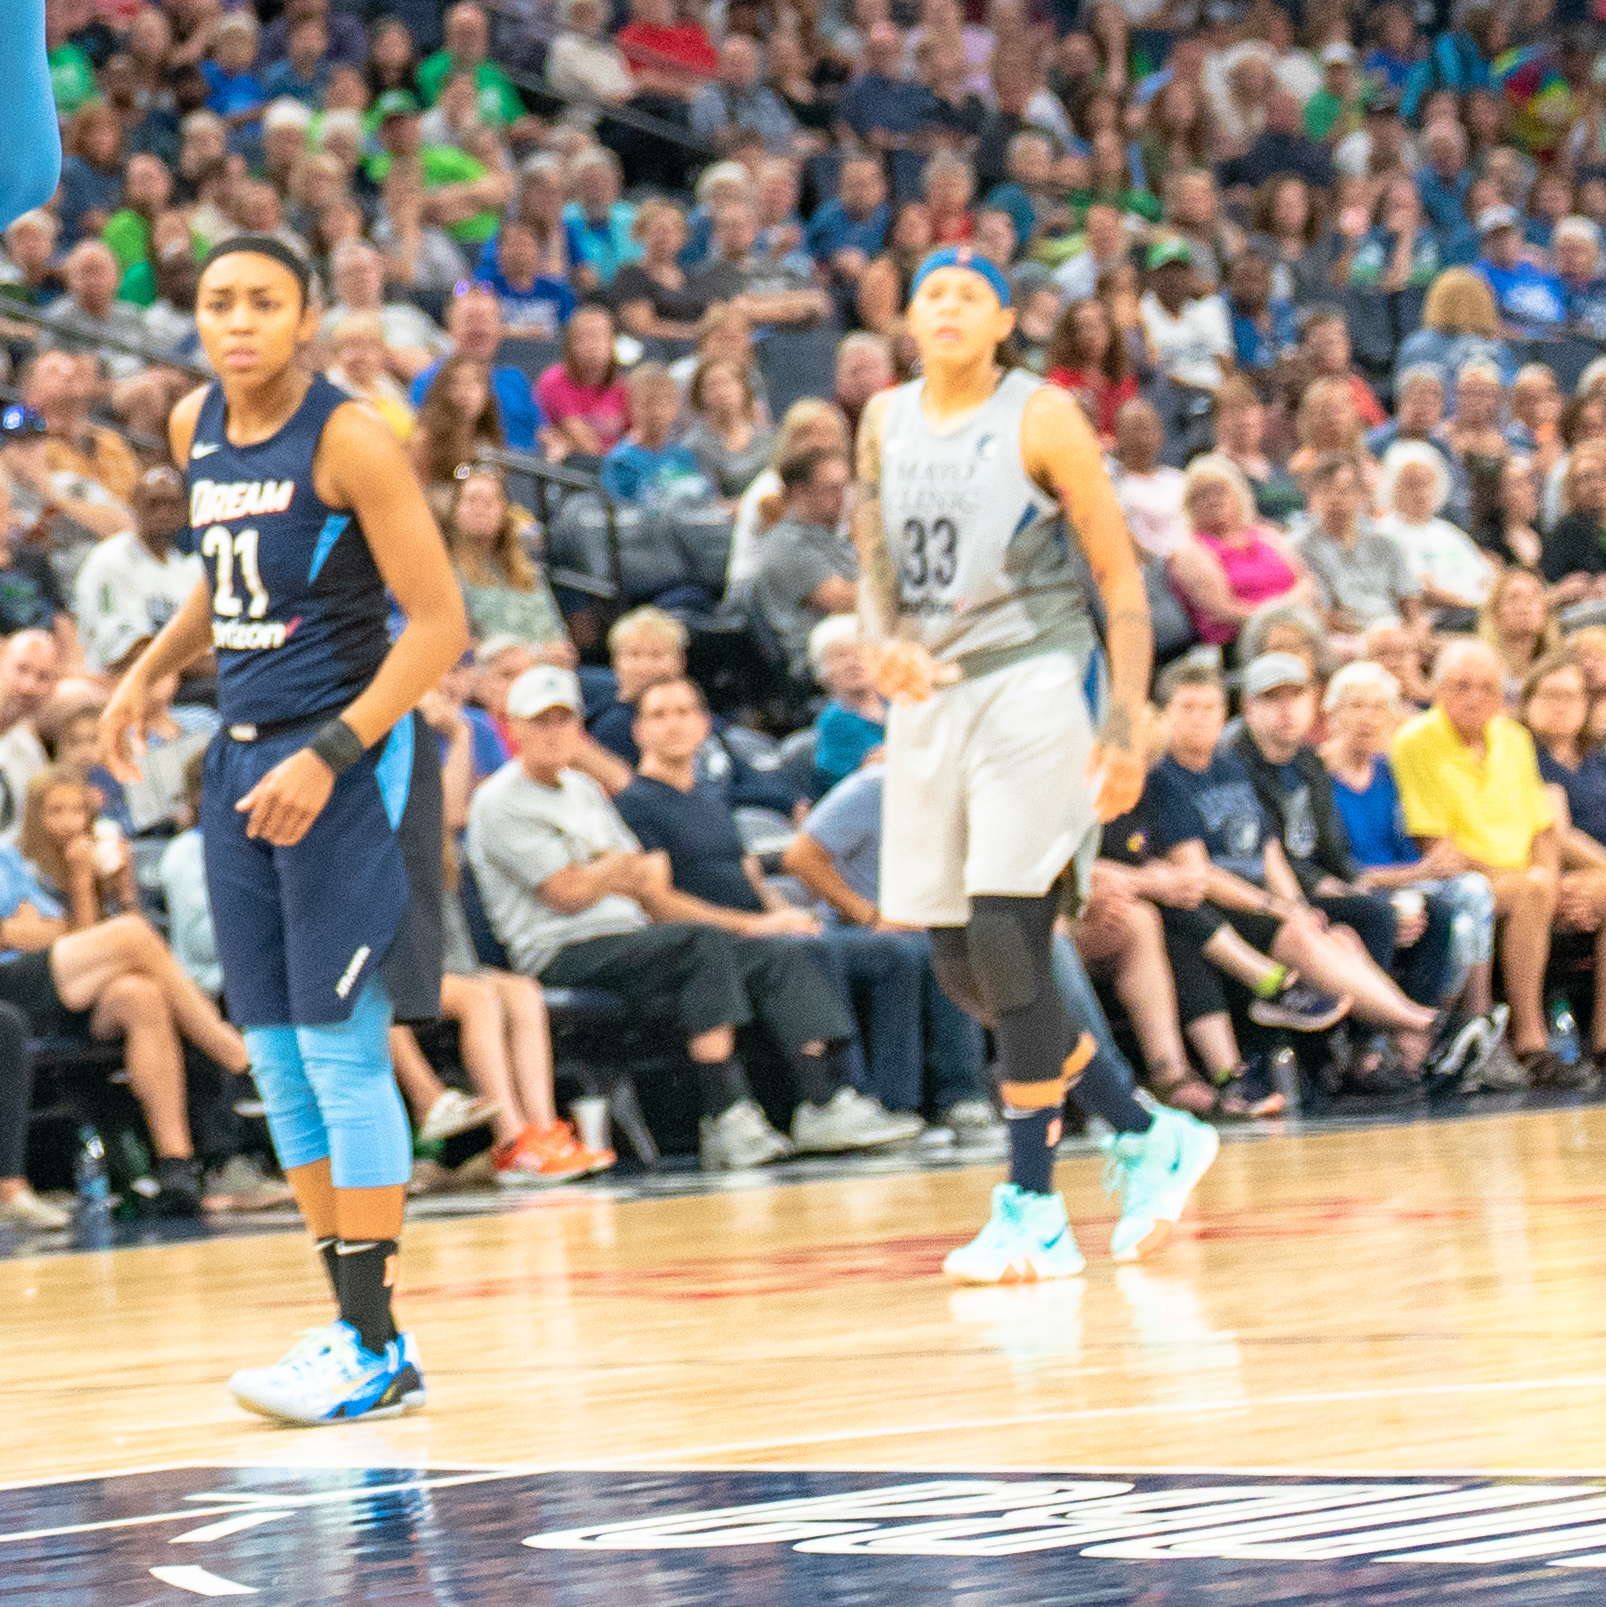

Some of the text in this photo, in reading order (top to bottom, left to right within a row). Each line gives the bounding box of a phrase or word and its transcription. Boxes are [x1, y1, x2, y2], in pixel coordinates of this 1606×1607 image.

[191, 478, 296, 529] DREAM
[201, 524, 270, 619] 21
[901, 516, 959, 590] 33
